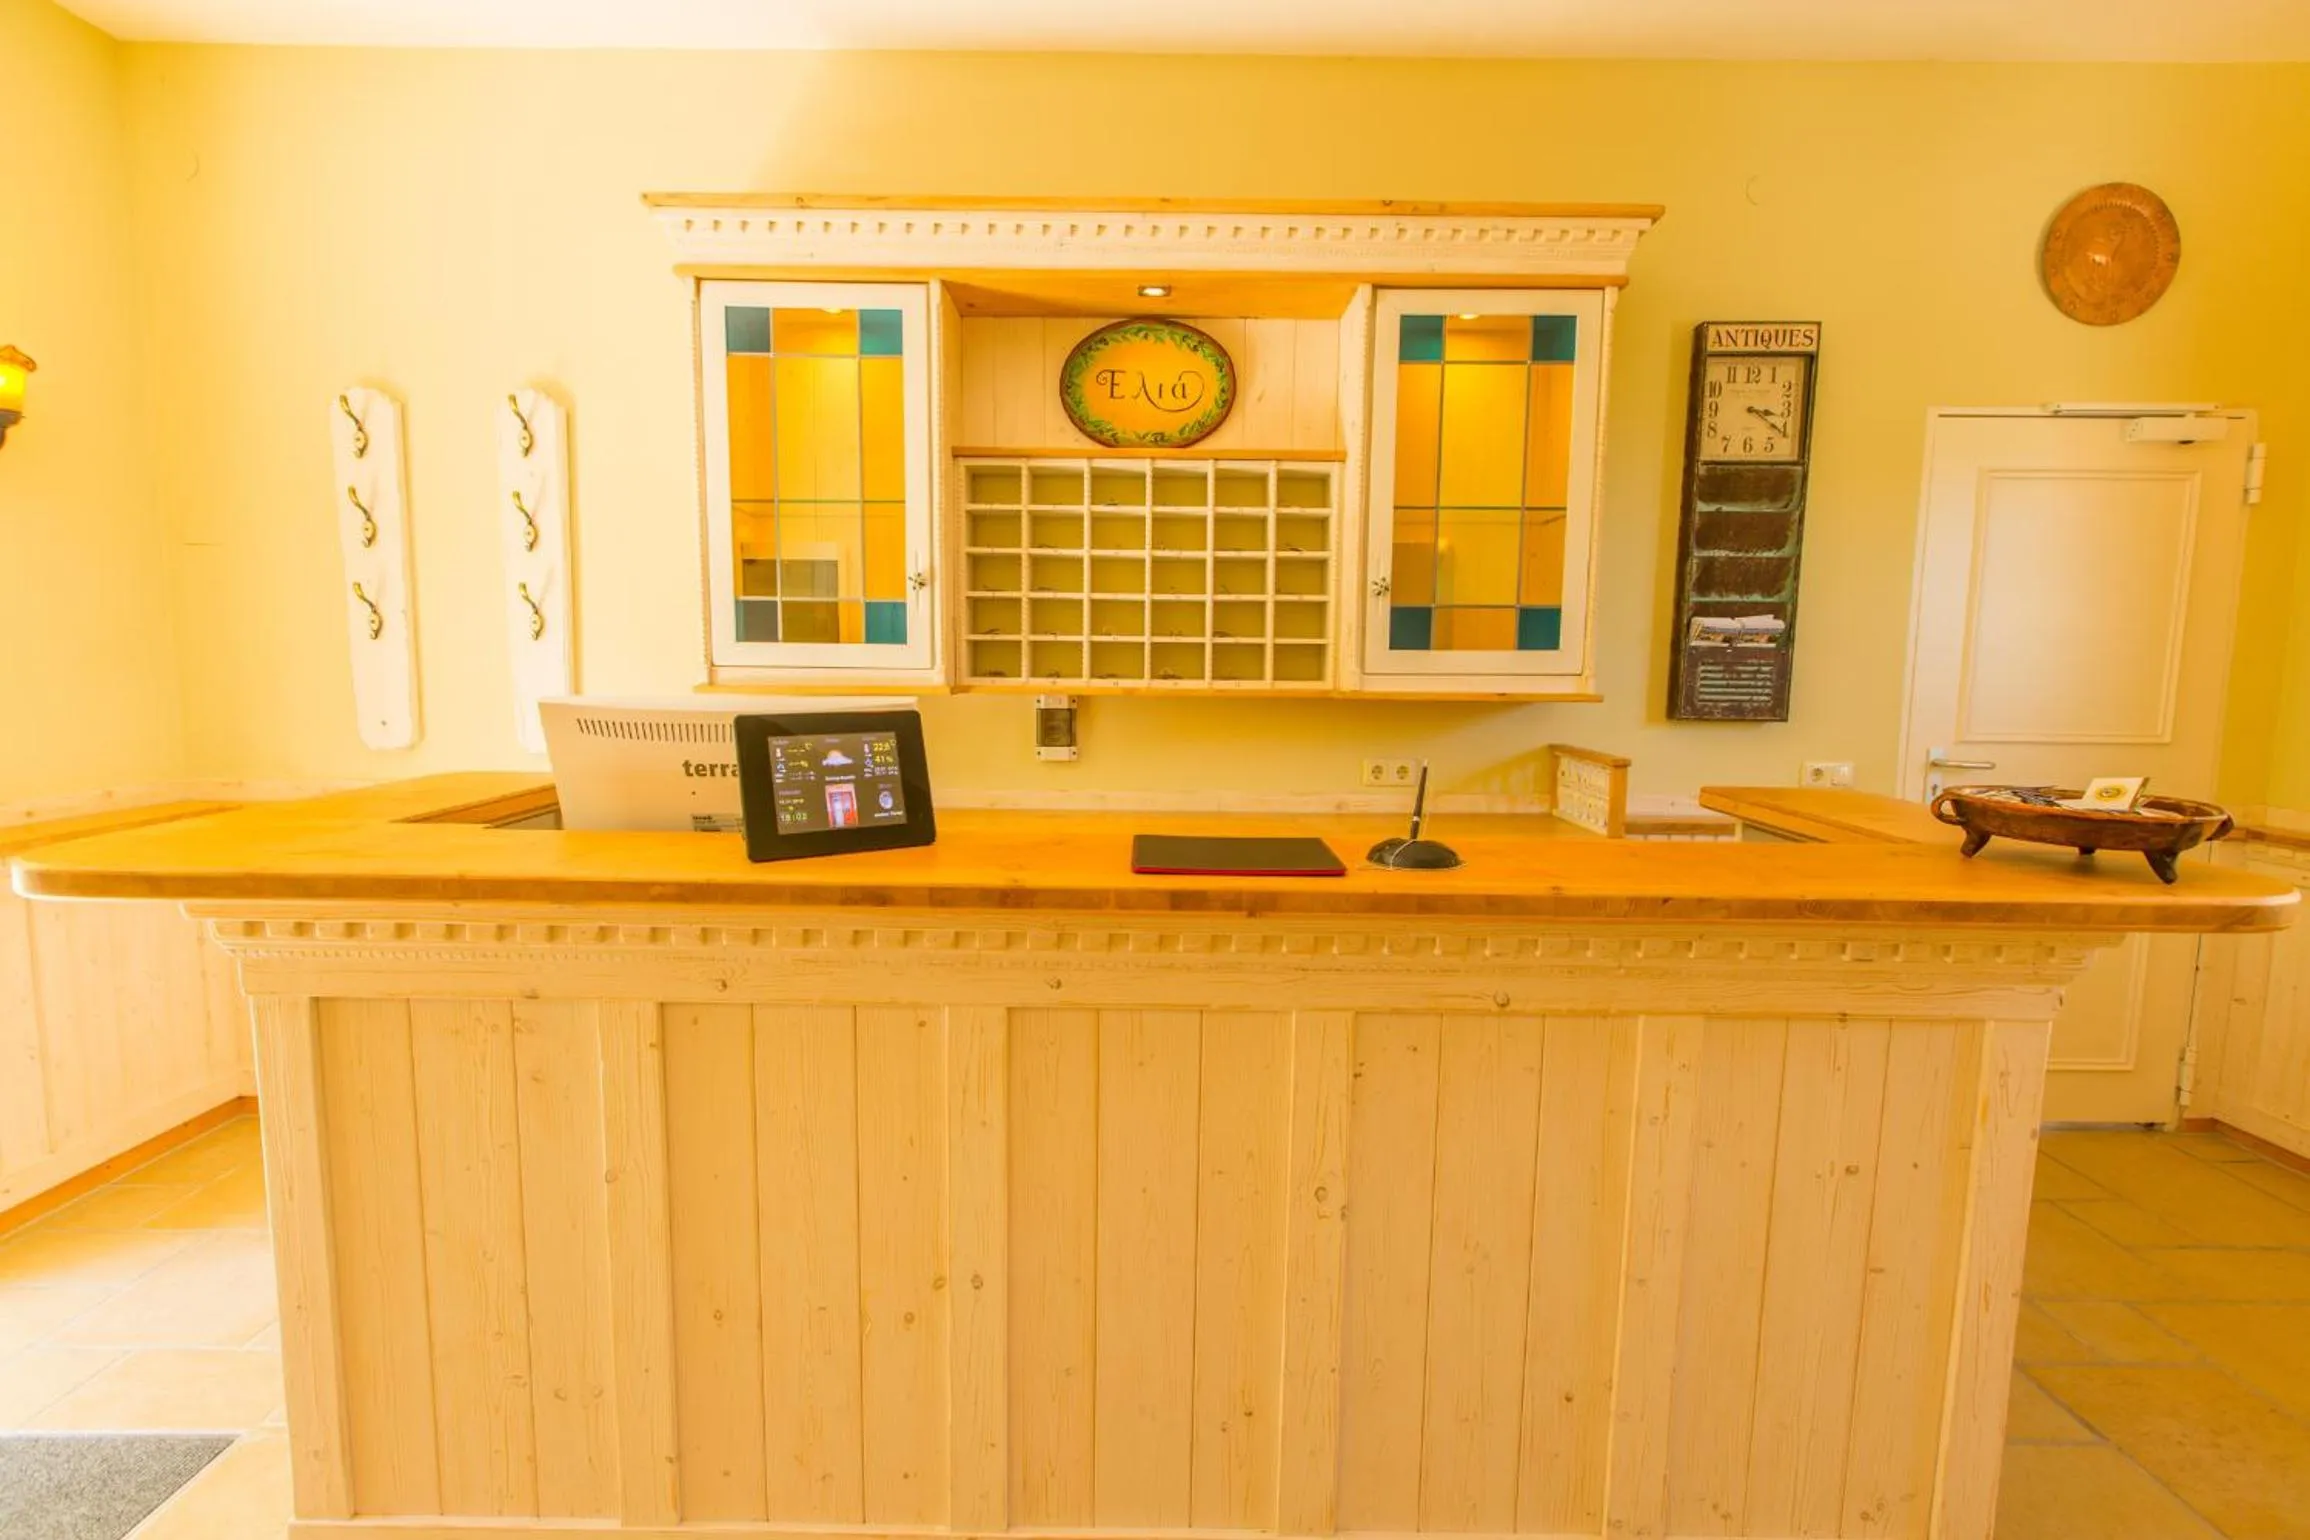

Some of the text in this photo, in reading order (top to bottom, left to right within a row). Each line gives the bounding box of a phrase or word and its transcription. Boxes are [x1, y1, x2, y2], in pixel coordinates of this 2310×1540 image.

[1711, 329, 1814, 349] ANTIQUES
[1726, 366, 1777, 384] 11 12 1
[1708, 380, 1722, 399] 10
[1782, 381, 1792, 399] 2
[1708, 401, 1718, 418] 9
[1780, 401, 1792, 418] 3
[1707, 421, 1718, 438] 8
[1722, 435, 1774, 453] 7 6 5
